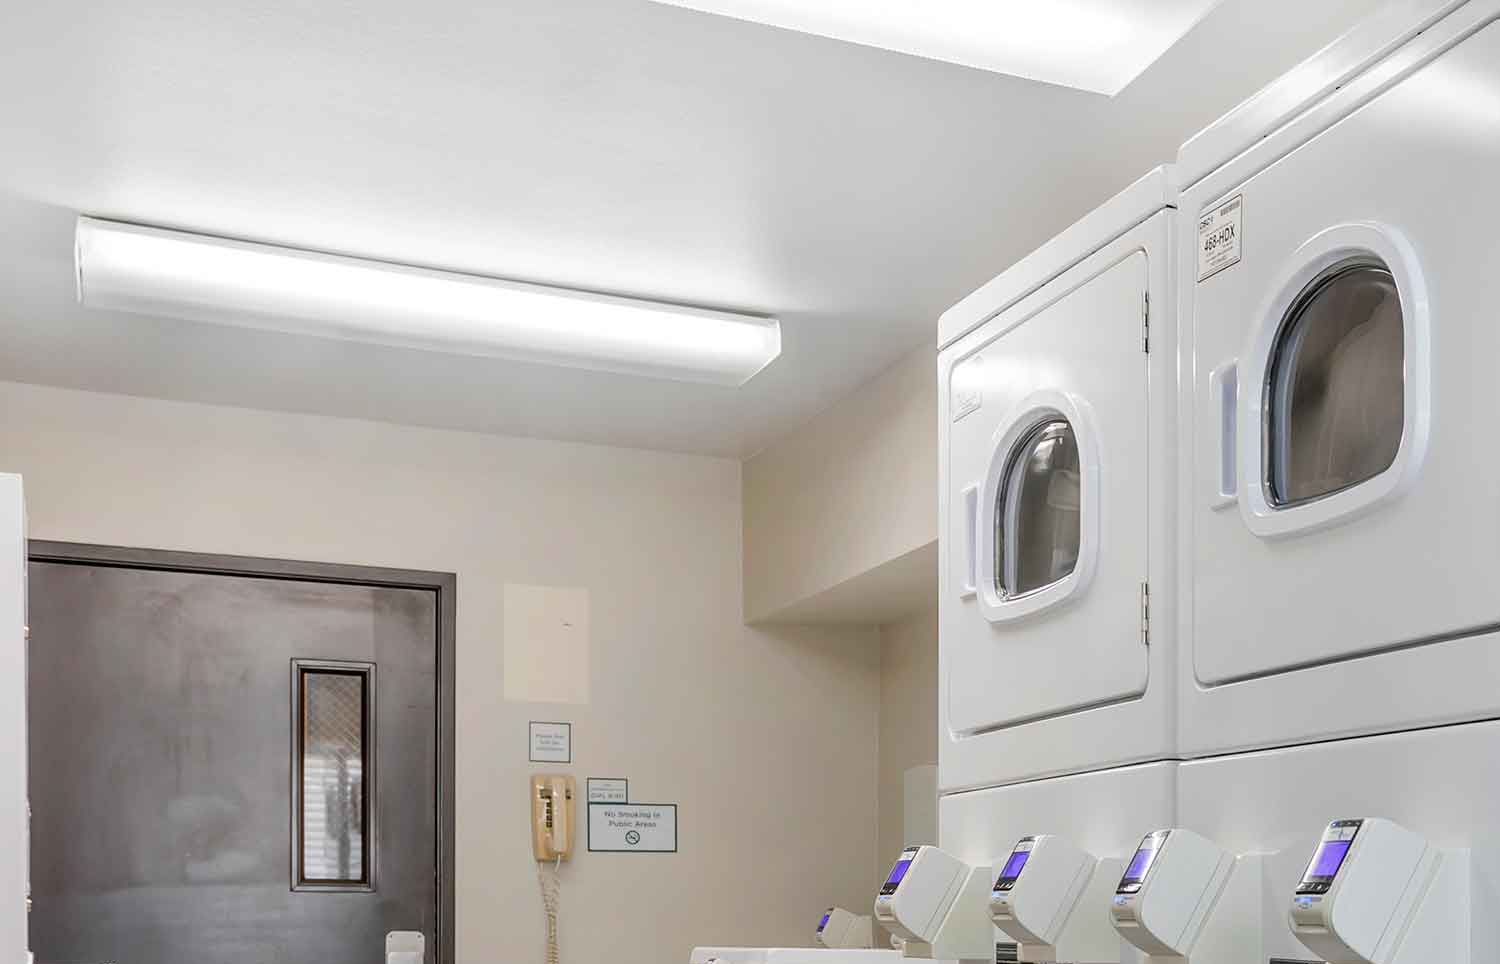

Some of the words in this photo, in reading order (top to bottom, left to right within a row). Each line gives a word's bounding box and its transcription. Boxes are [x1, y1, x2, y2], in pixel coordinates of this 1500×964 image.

[618, 811, 651, 819] Smoking
[608, 820, 633, 828] Public
[635, 820, 657, 828] Areas
